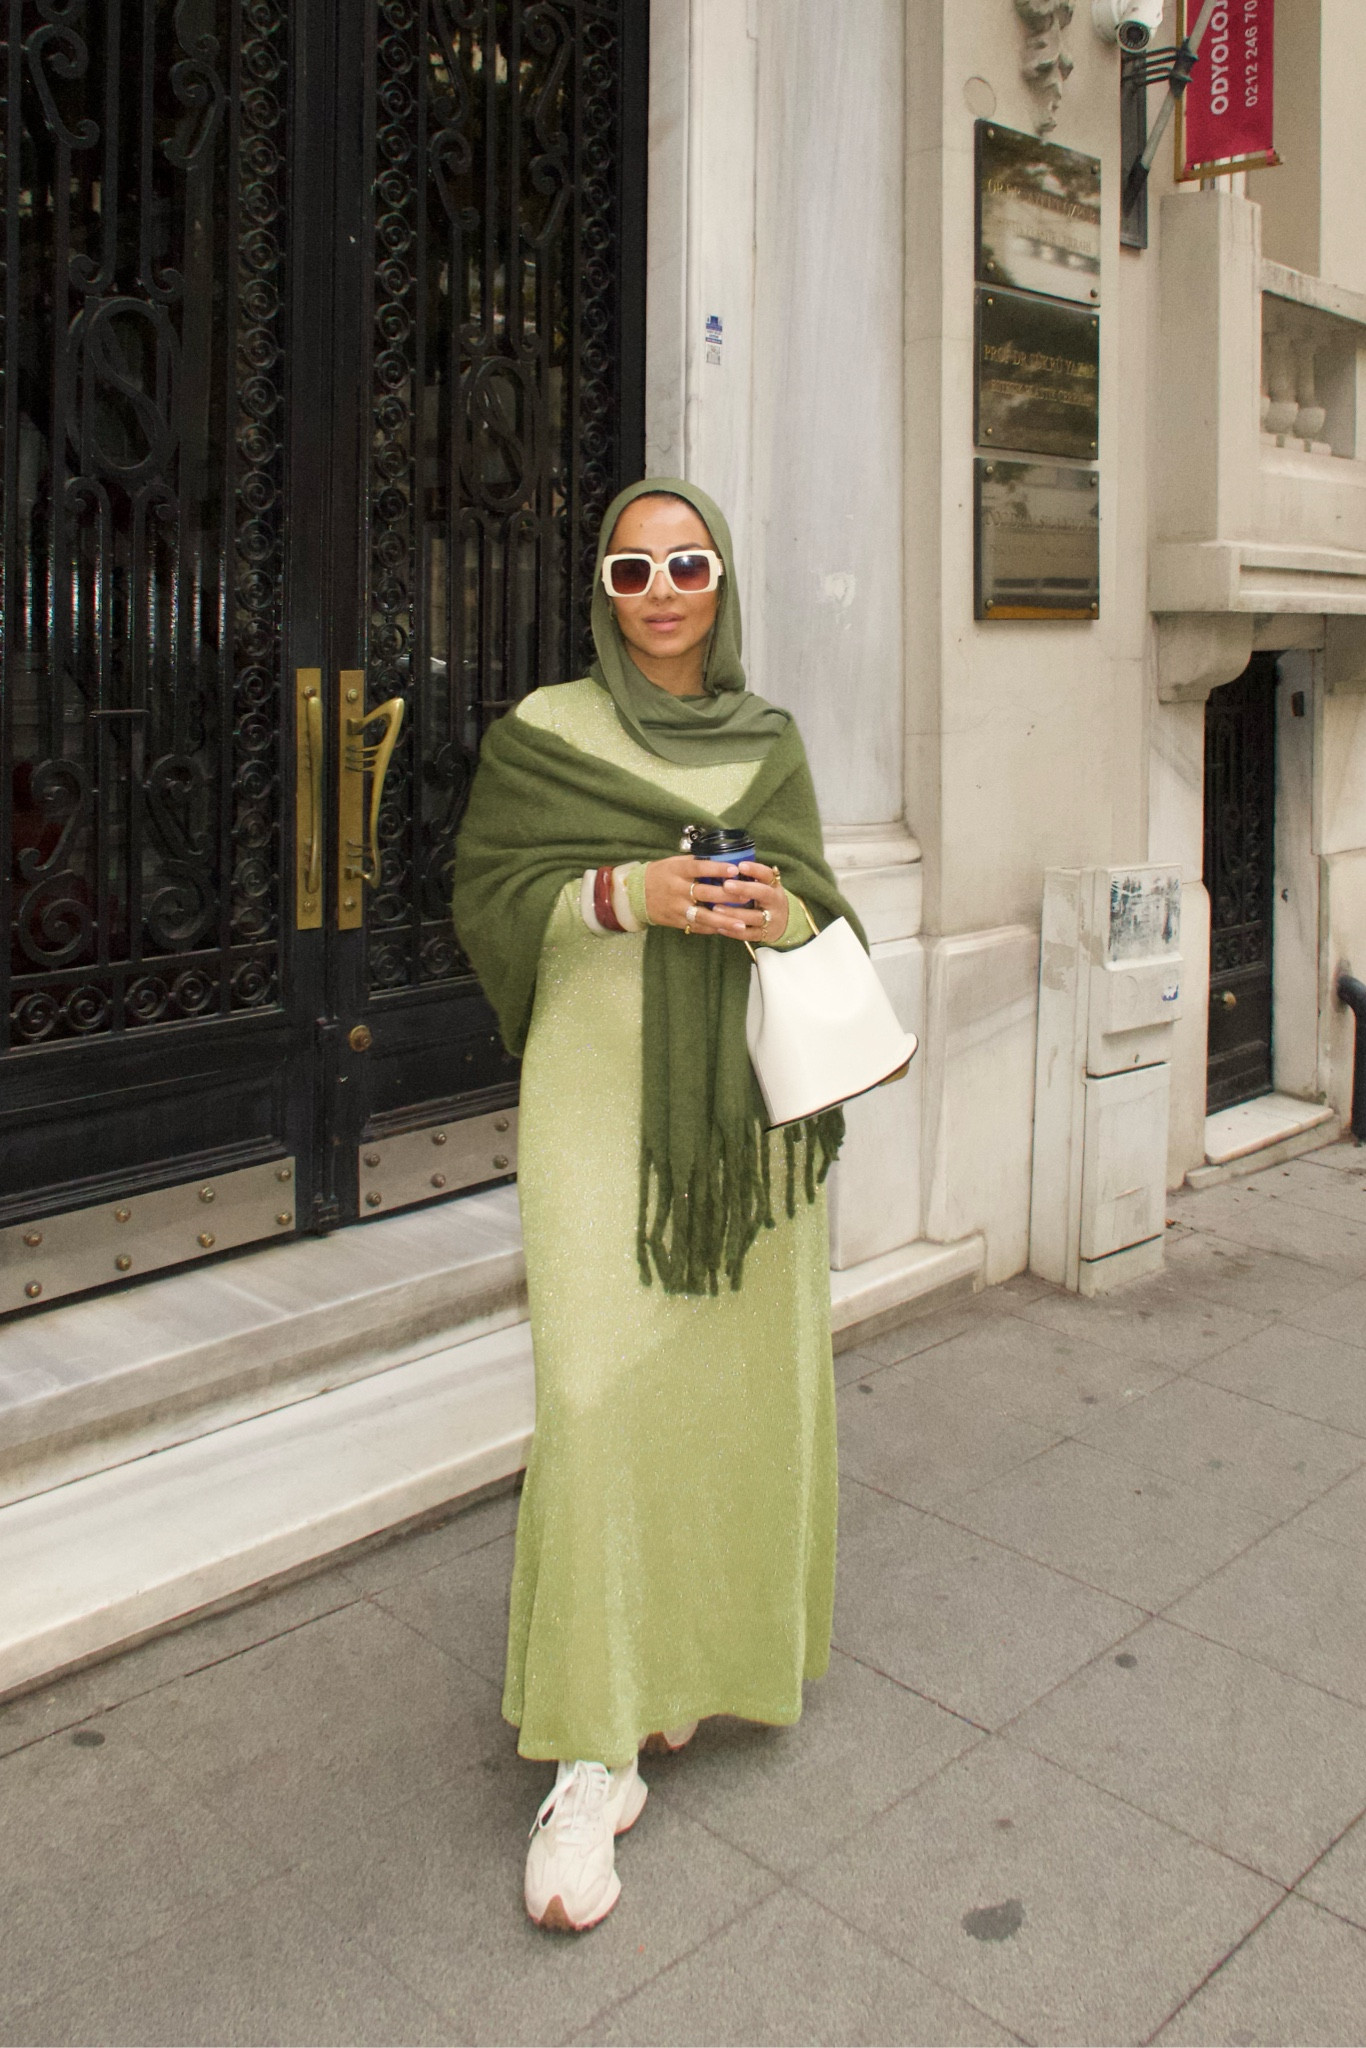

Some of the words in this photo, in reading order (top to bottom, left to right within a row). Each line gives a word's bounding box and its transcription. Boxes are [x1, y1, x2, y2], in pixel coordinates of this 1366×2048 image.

[1243, 0, 1259, 24] 70
[1244, 25, 1259, 60] 246
[1244, 61, 1259, 108] 0212
